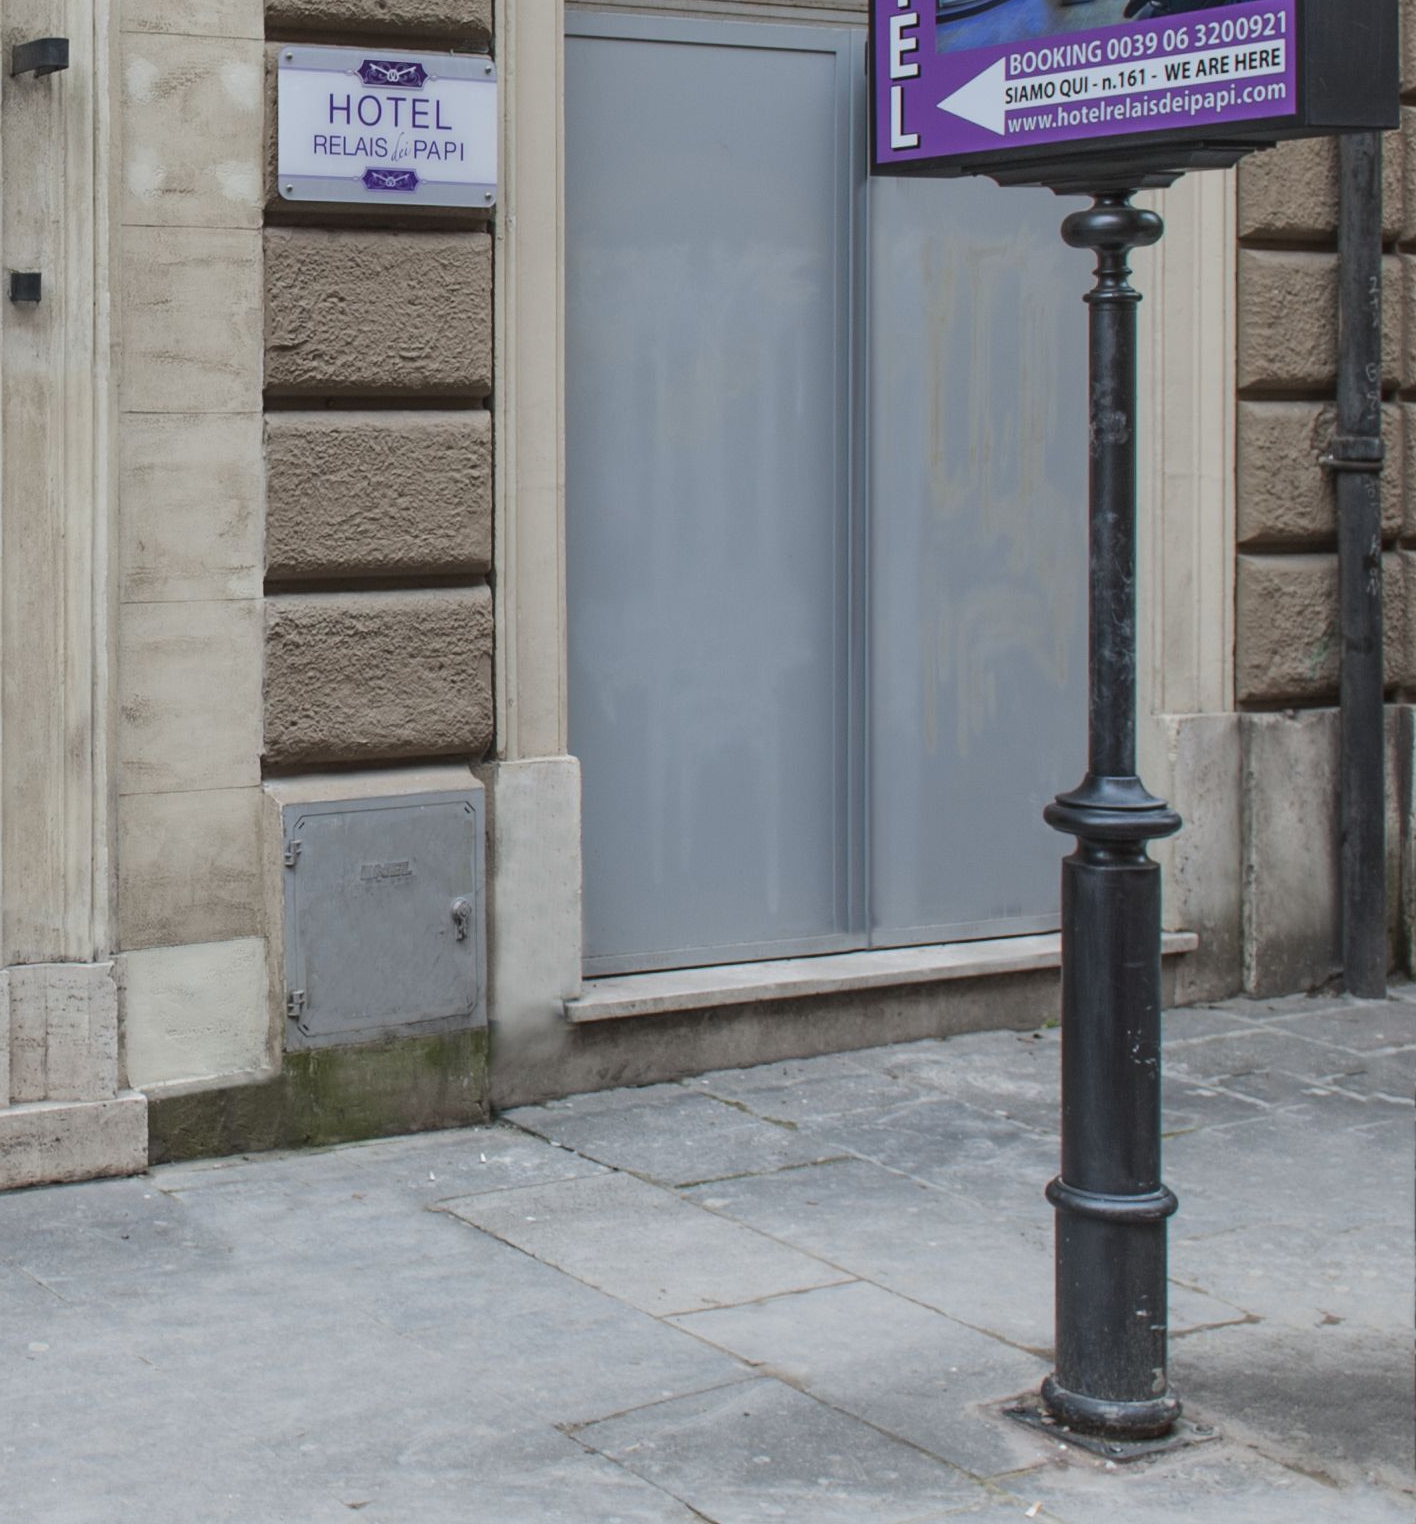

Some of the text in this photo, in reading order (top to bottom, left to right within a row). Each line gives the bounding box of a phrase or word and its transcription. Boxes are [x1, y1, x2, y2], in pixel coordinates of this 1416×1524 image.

[1009, 10, 1287, 75] BOOKING 0039 06 3200921
[1004, 82, 1056, 105] SIAMO
[1059, 77, 1089, 98] QUI
[1101, 68, 1146, 92] n.161
[1164, 60, 1191, 82] WE
[1195, 55, 1230, 77] ARE
[1234, 47, 1282, 71] HERE
[329, 93, 453, 131] HOTEL
[1008, 82, 1287, 133] www.hotelrelaisdeipapi.com
[313, 132, 464, 162] RELAIS dei PAPI
